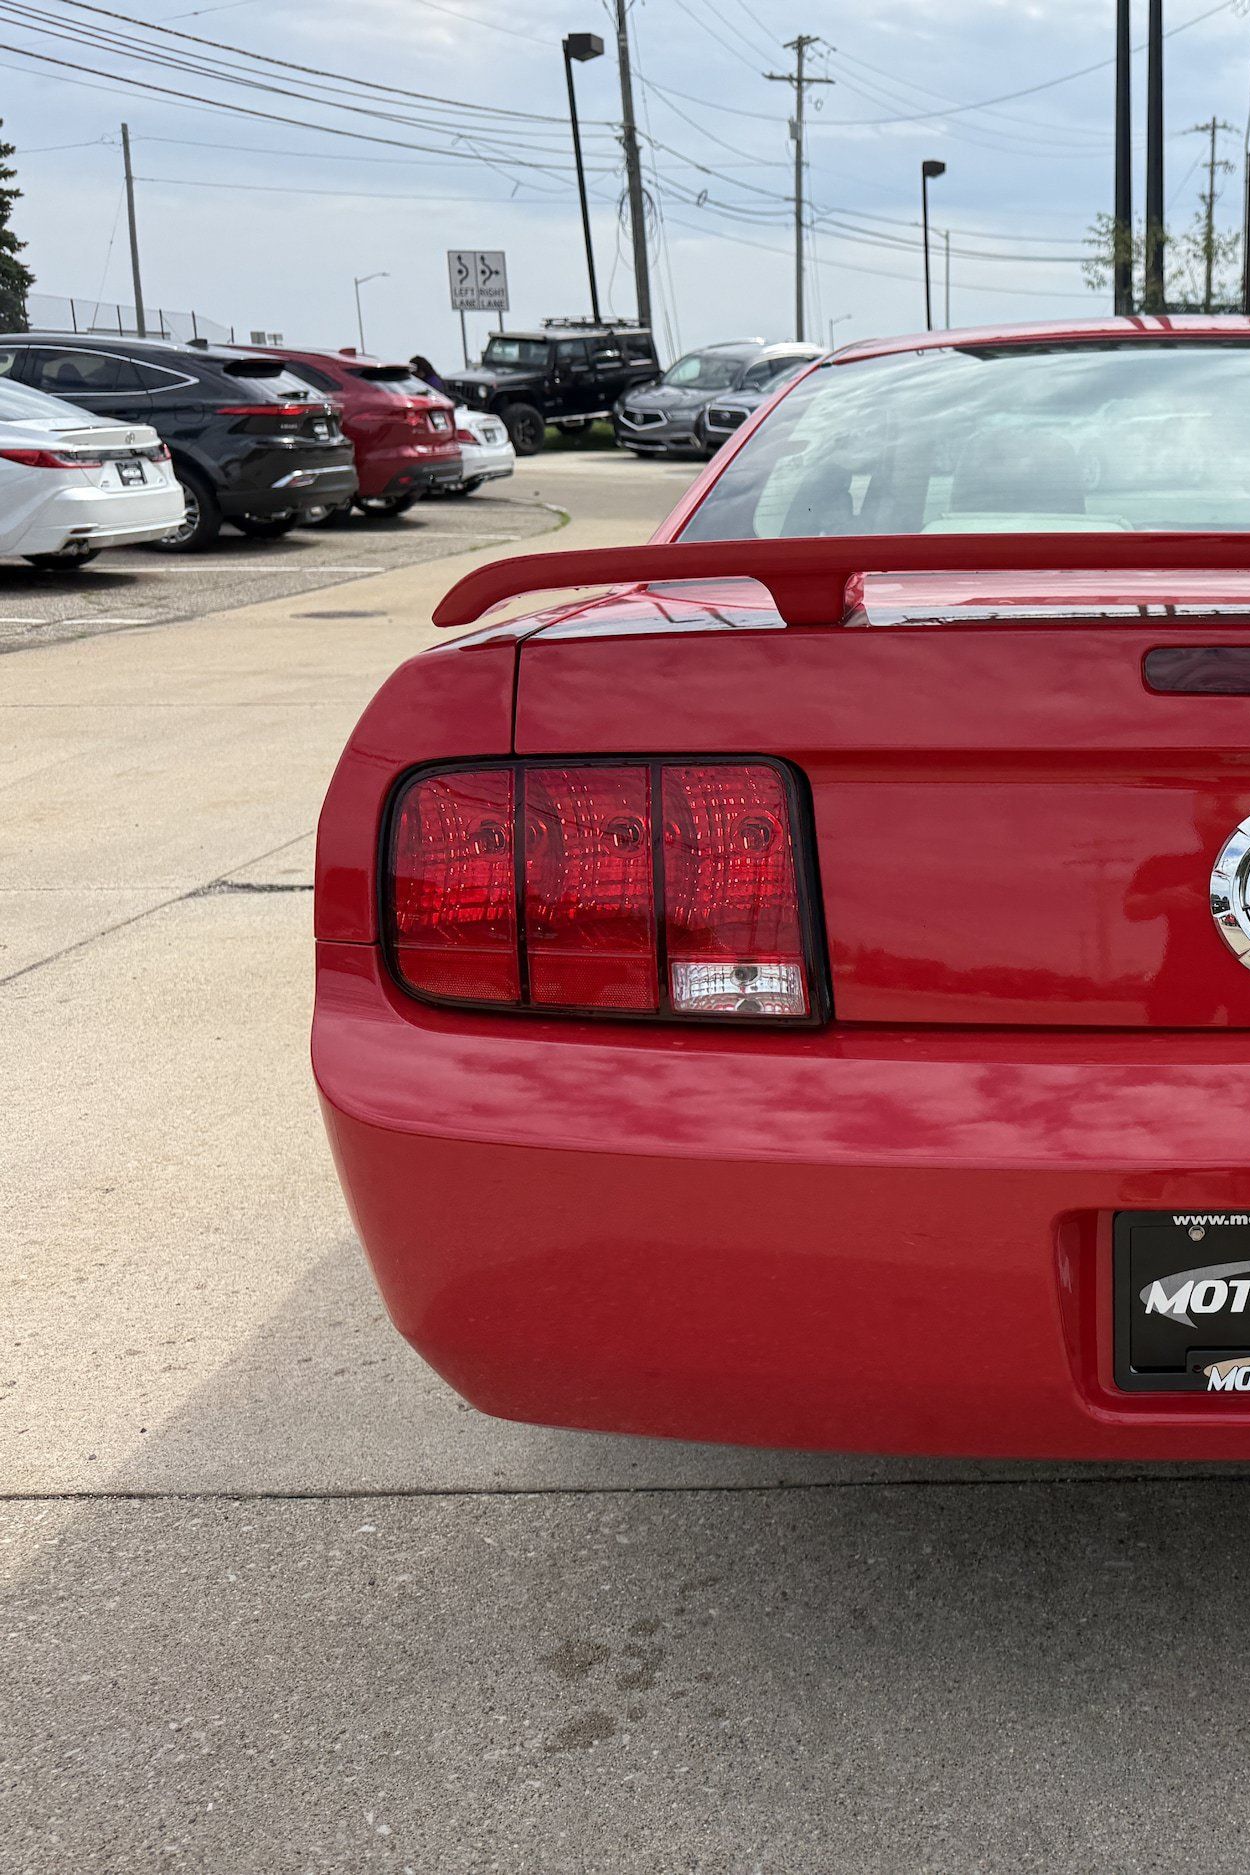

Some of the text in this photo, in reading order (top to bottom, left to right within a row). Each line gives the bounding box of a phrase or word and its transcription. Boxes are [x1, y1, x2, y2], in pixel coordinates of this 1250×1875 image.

[453, 287, 475, 298] LEFT
[479, 288, 505, 298] RIGHT
[453, 299, 477, 308] LANE
[481, 299, 505, 308] LANE
